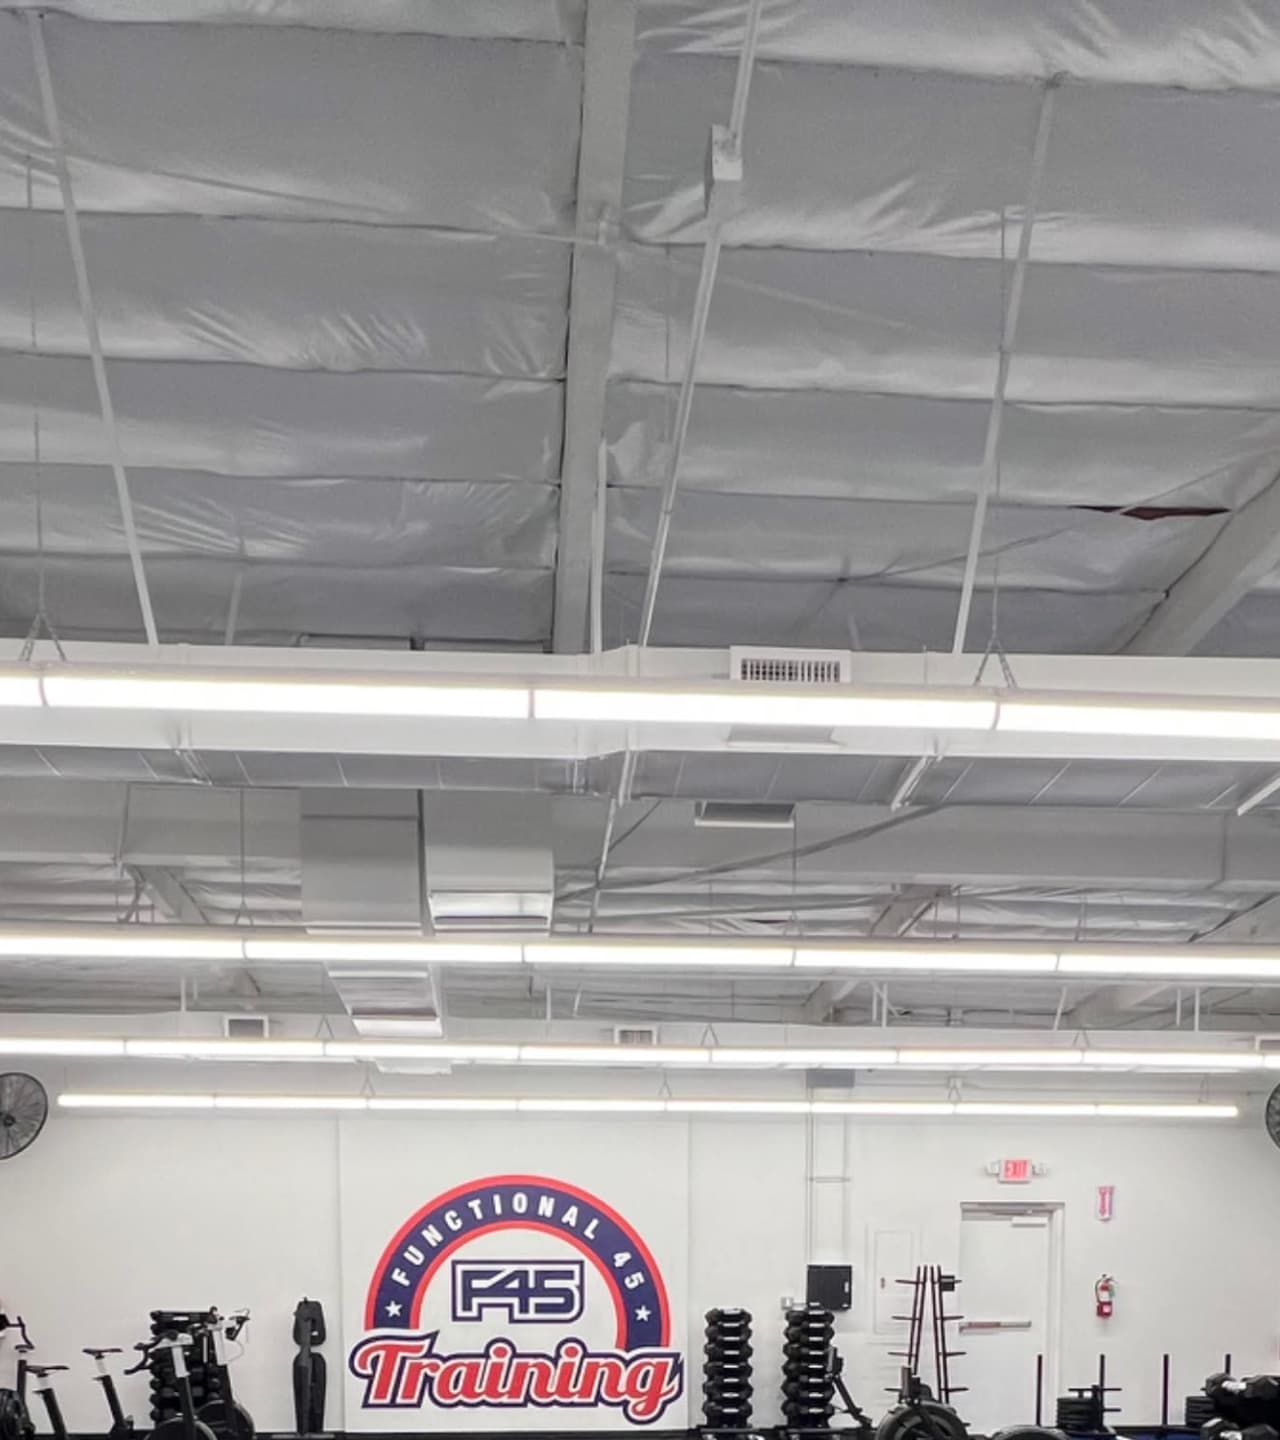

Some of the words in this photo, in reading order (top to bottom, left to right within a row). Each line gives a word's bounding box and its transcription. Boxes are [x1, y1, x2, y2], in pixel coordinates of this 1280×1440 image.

[391, 1193, 598, 1287] FUNCTIONAL
[613, 1250, 646, 1291] 45
[451, 1259, 585, 1324] F45
[349, 1330, 685, 1425] Training
